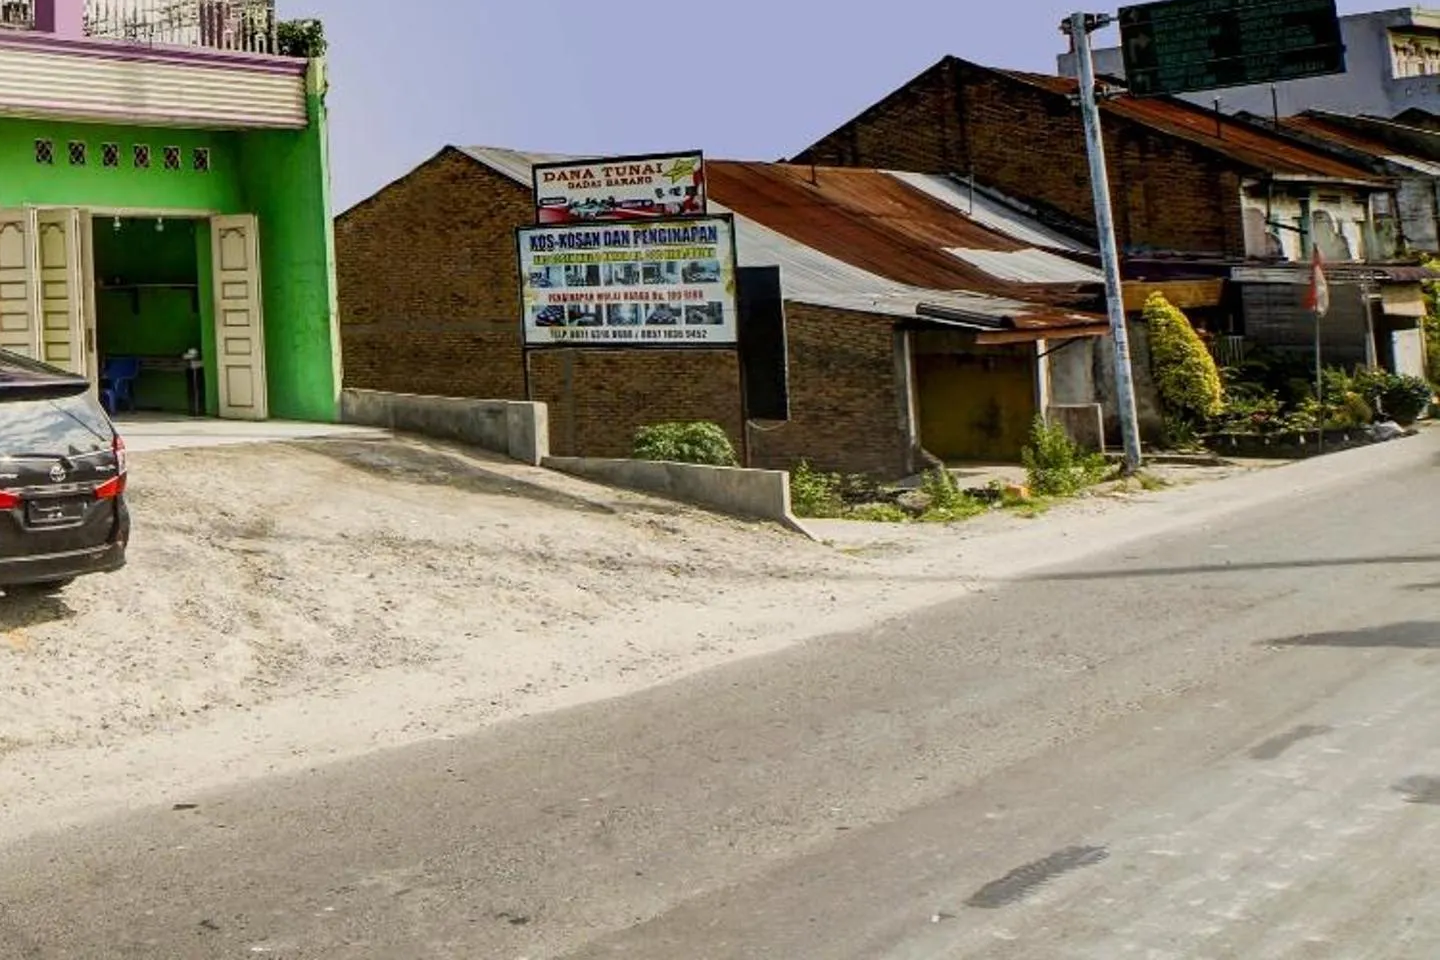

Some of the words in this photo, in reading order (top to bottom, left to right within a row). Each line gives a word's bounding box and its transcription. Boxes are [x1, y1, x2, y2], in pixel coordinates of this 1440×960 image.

[542, 168, 595, 183] DANA
[602, 162, 663, 178] TUNAI
[530, 231, 601, 252] KOS-KOSAN
[604, 229, 631, 247] DAN
[633, 225, 718, 245] PENGINAPAN
